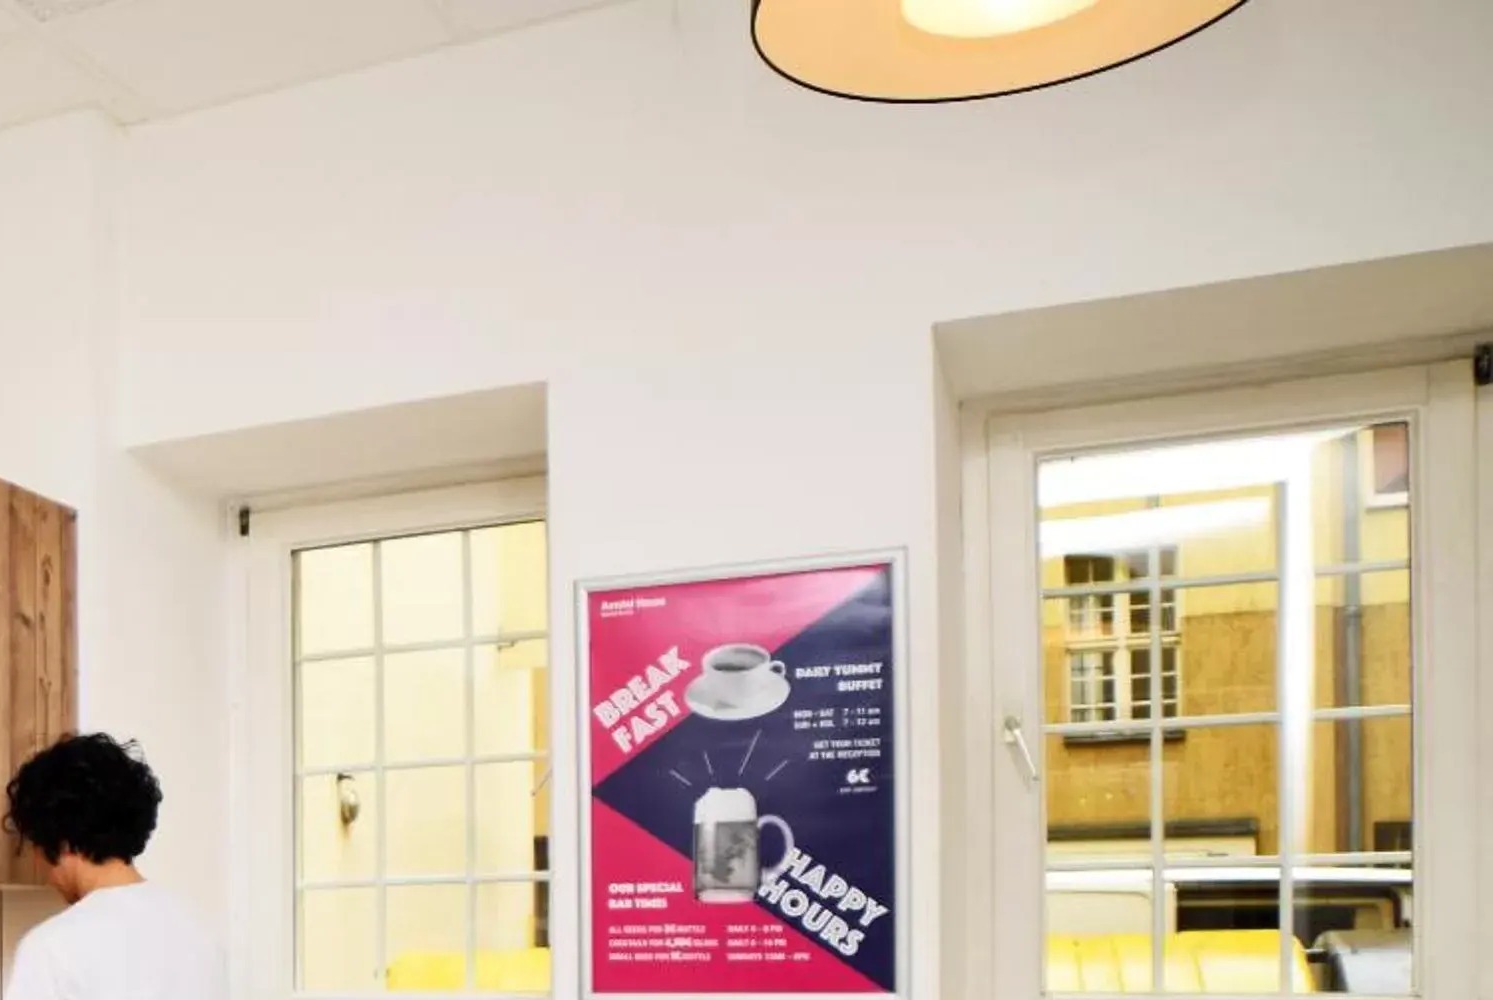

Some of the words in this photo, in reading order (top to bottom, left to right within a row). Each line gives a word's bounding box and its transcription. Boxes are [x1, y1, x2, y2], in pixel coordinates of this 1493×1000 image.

[593, 645, 692, 729] BREAK
[795, 666, 830, 678] DAILY
[833, 662, 884, 676] YUMMY
[837, 678, 884, 692] BUFFET
[611, 690, 682, 754] FAST
[608, 882, 634, 894] OUR
[635, 881, 684, 893] SPECIAL
[759, 871, 865, 956] HOURS
[780, 847, 890, 926] HAPPY
